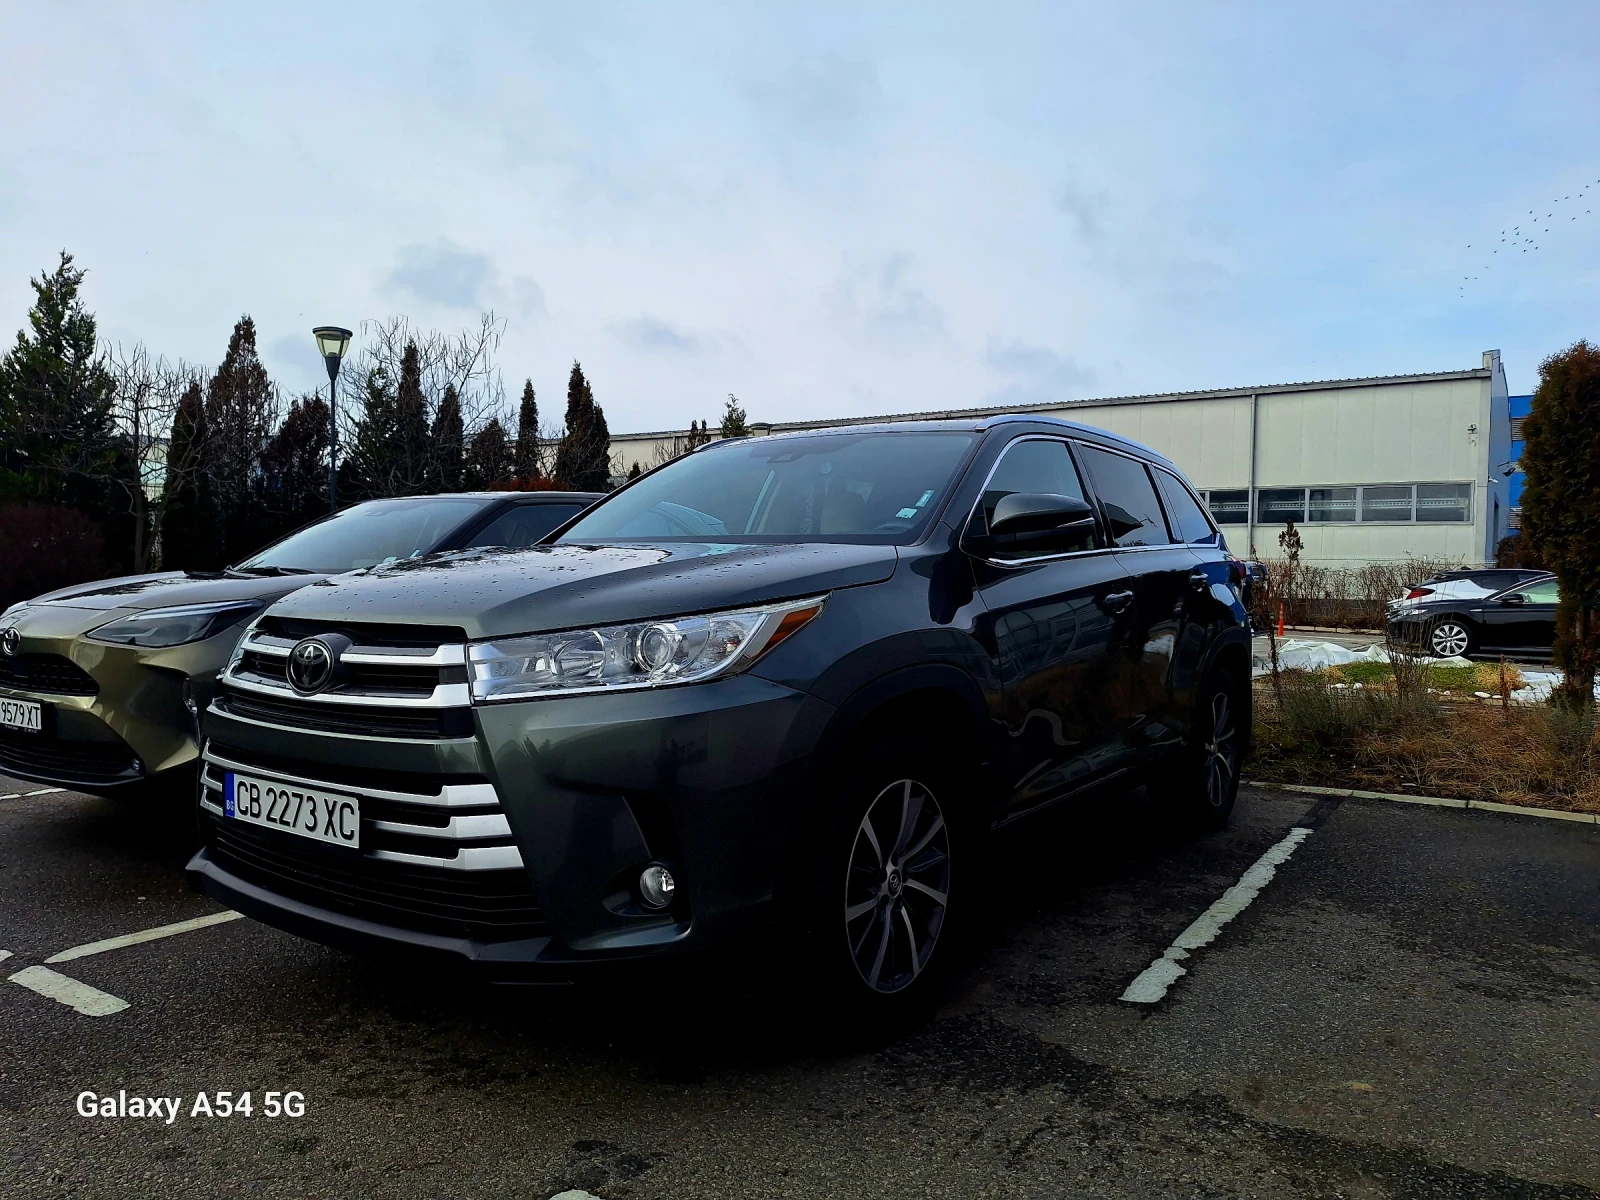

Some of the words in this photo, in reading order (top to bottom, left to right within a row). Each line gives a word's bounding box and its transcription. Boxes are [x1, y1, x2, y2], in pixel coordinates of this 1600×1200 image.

[1, 700, 25, 725] 9579
[26, 704, 40, 728] XT
[236, 780, 262, 819] CB
[265, 786, 318, 833] 2273
[323, 797, 356, 841] XC
